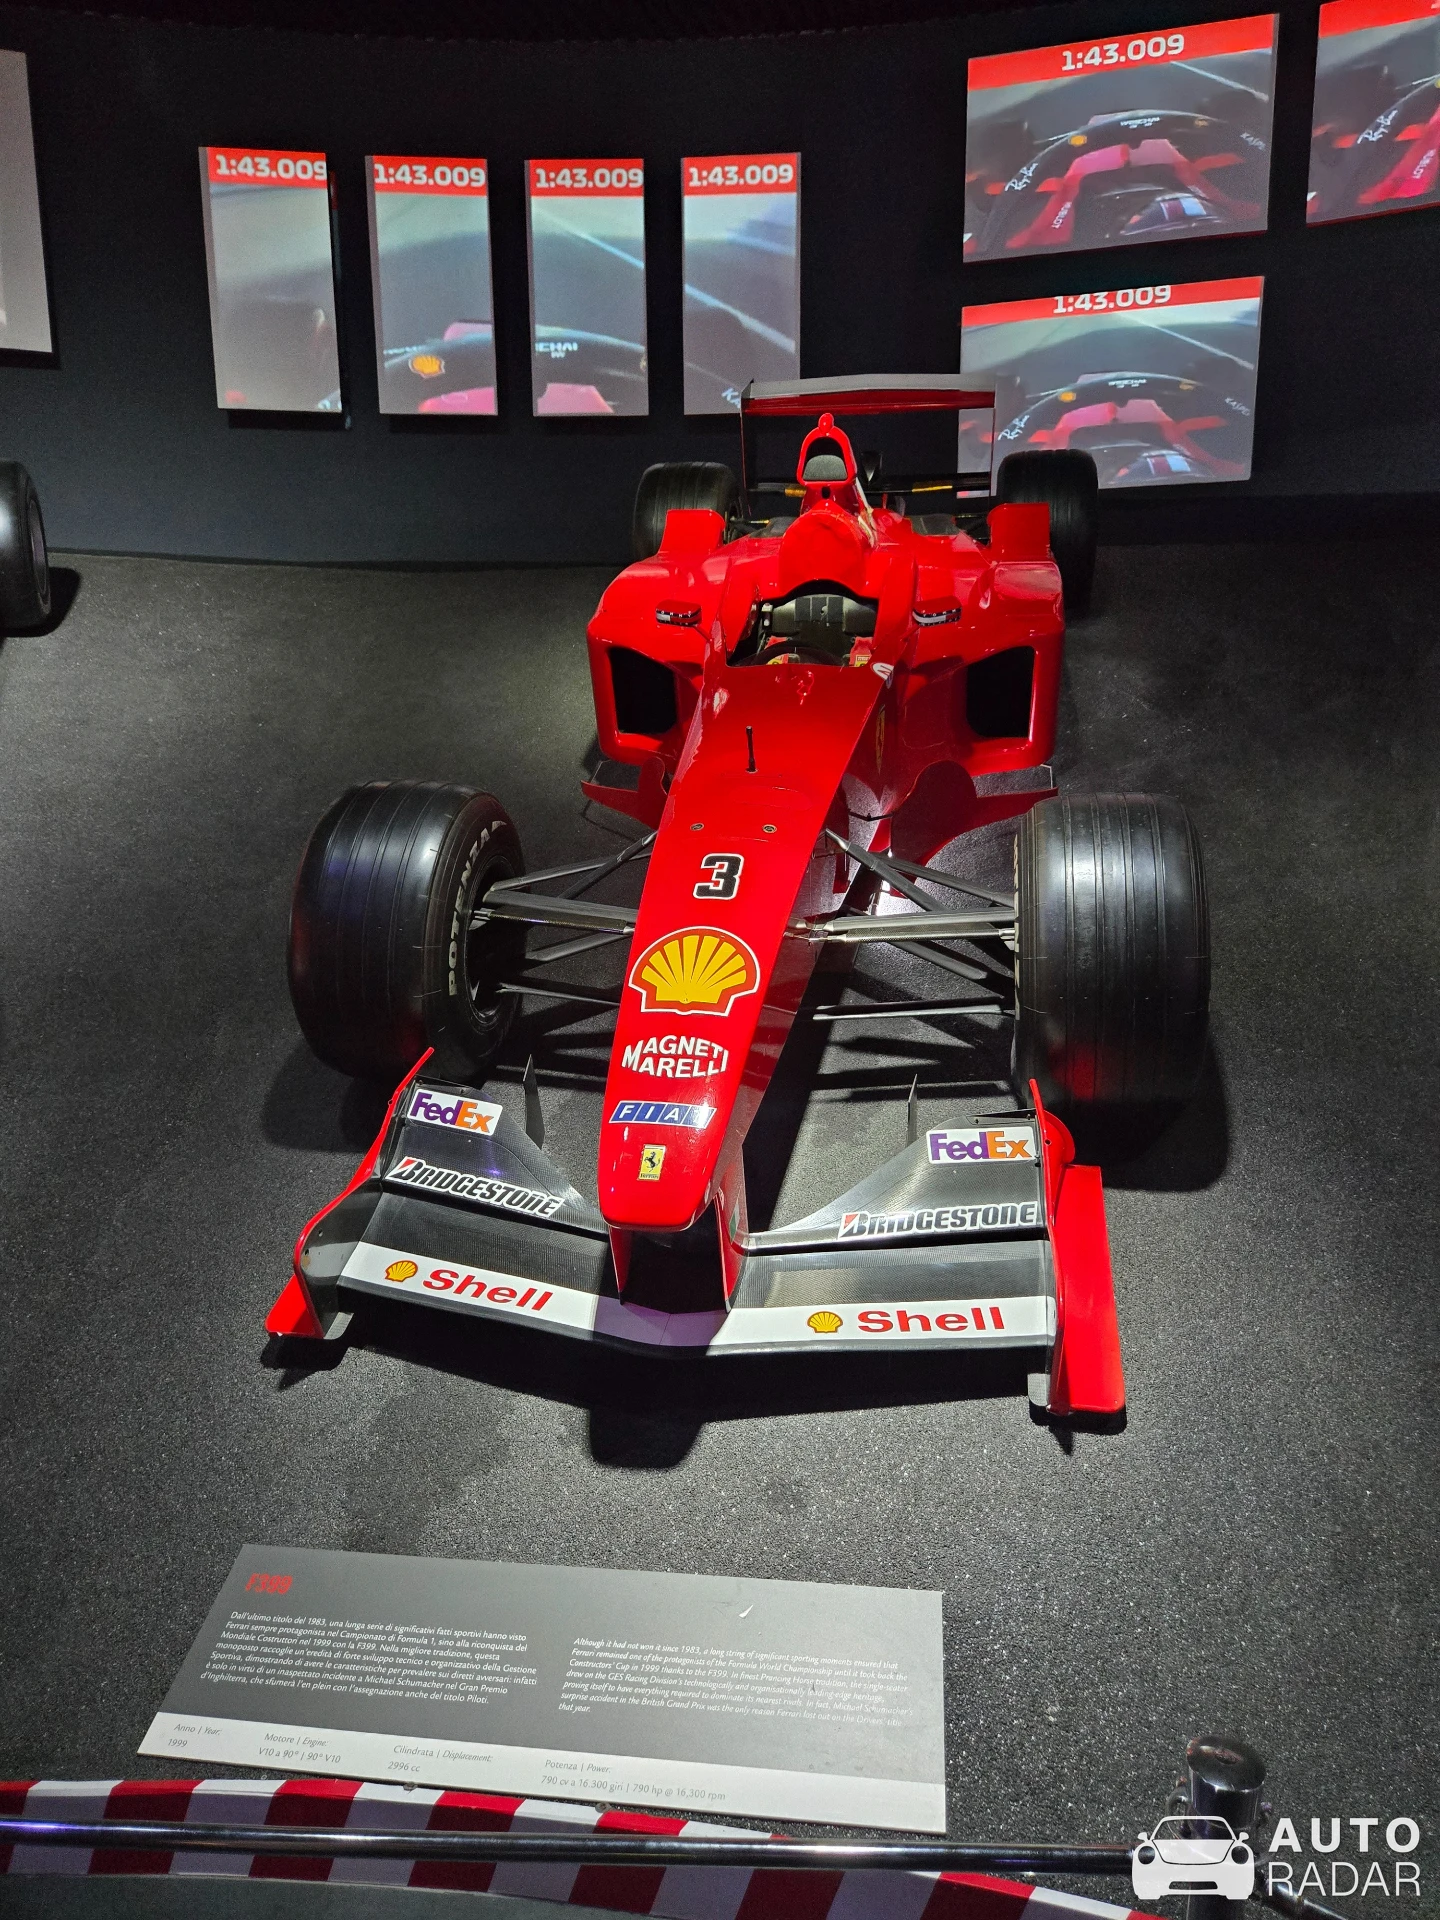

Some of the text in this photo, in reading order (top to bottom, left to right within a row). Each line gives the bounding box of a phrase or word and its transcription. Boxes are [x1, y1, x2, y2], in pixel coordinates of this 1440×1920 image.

[1062, 33, 1185, 71] 1:43.009
[216, 154, 327, 181] 1:43.009
[374, 163, 486, 187] 1:43.009
[535, 167, 644, 189] 1:43.009
[689, 163, 794, 187] 1:43.009
[1053, 285, 1172, 314] 1:43.009
[693, 853, 744, 900] 3
[622, 1035, 729, 1066] MAGNETI
[622, 1046, 729, 1078] MARELLI
[409, 1092, 495, 1133] FedEx
[930, 1131, 1033, 1161] FedEx
[387, 1158, 562, 1215] BRIDGESTONE
[841, 1203, 1038, 1238] BRIDGESTONE
[422, 1269, 554, 1311] Shell
[858, 1306, 1005, 1333] Shell
[245, 1572, 294, 1595] F399
[225, 1620, 250, 1630] Ferrari
[250, 1624, 278, 1633] sempre
[277, 1627, 326, 1637] protagonista
[326, 1629, 340, 1637] nel
[339, 1630, 387, 1641] Campionato
[387, 1633, 396, 1642] di
[396, 1634, 428, 1644] Formula
[455, 1639, 470, 1648] alla
[470, 1640, 514, 1651] riconquista
[514, 1643, 528, 1652] del
[272, 1614, 293, 1623] titolo
[293, 1616, 307, 1624] del
[344, 1620, 366, 1631] lunga
[366, 1622, 384, 1631] serie
[384, 1623, 393, 1631] di
[393, 1624, 435, 1634] significativi
[436, 1626, 453, 1636] fatti
[453, 1630, 482, 1638] sportivi
[482, 1630, 508, 1640] hanno
[215, 1642, 259, 1652] monoposto
[259, 1646, 294, 1656] raccoglie
[333, 1650, 342, 1658] di
[342, 1650, 361, 1660] forte
[361, 1653, 394, 1664] sviluppo
[395, 1657, 423, 1665] tecnico
[430, 1660, 481, 1670] organizzativo
[482, 1662, 501, 1671] della
[502, 1663, 537, 1675] Gestione
[220, 1630, 256, 1641] Mondiale
[256, 1633, 298, 1644] Costruttori
[298, 1637, 312, 1645] nel
[313, 1638, 332, 1647] 1999
[347, 1640, 355, 1649] la
[379, 1643, 399, 1653] Nella
[400, 1646, 432, 1656] migliore
[432, 1648, 472, 1659] tradizione,
[474, 1652, 500, 1661] questa
[573, 1637, 605, 1649] Although
[605, 1639, 612, 1648] it
[612, 1639, 627, 1649] had
[626, 1642, 639, 1650] not
[654, 1643, 661, 1651] it
[709, 1646, 725, 1658] long
[725, 1649, 746, 1660] string
[746, 1649, 756, 1660] of
[754, 1651, 790, 1661] significant
[790, 1655, 819, 1666] sporting
[819, 1657, 852, 1666] moments
[853, 1659, 882, 1668] ensured
[882, 1660, 898, 1669] that
[210, 1650, 243, 1662] Sportiva,
[244, 1653, 294, 1665] dimostrando
[294, 1658, 303, 1666] di
[303, 1660, 324, 1668] avere
[324, 1659, 332, 1669] le
[333, 1663, 387, 1673] caratteristiche
[386, 1667, 402, 1675] per
[400, 1667, 437, 1677] prevalere
[450, 1670, 475, 1680] diretti
[513, 1675, 537, 1685] infatti
[211, 1661, 228, 1670] solo
[228, 1662, 237, 1671] in
[238, 1665, 256, 1673] virtù
[256, 1665, 265, 1673] di
[276, 1669, 321, 1678] inaspettato
[321, 1672, 357, 1682] incidente
[364, 1674, 396, 1685] Michael
[395, 1677, 445, 1689] Schumacher
[444, 1681, 458, 1690] nel
[458, 1682, 479, 1691] Gran
[480, 1684, 508, 1694] Premio
[249, 1675, 264, 1684] che
[264, 1676, 296, 1687] sfumerà
[311, 1681, 332, 1691] plein
[332, 1684, 348, 1692] con
[404, 1689, 429, 1699] anche
[429, 1690, 443, 1700] del
[443, 1693, 465, 1702] titolo
[466, 1694, 489, 1704] Piloti.
[173, 1723, 196, 1733] Anno
[263, 1732, 295, 1744] Motore
[167, 1738, 188, 1748] 1999
[258, 1746, 275, 1756] V10
[325, 1753, 341, 1763] V10
[393, 1744, 434, 1757] Cilindrata
[387, 1760, 409, 1771] 2996
[544, 1759, 578, 1770] Potenza
[540, 1774, 558, 1785] 790
[559, 1778, 569, 1786] cv
[608, 1781, 623, 1793] giri
[632, 1783, 650, 1794] 790
[651, 1784, 663, 1798] hp
[676, 1787, 706, 1799] 16,300
[707, 1792, 726, 1802] rpm
